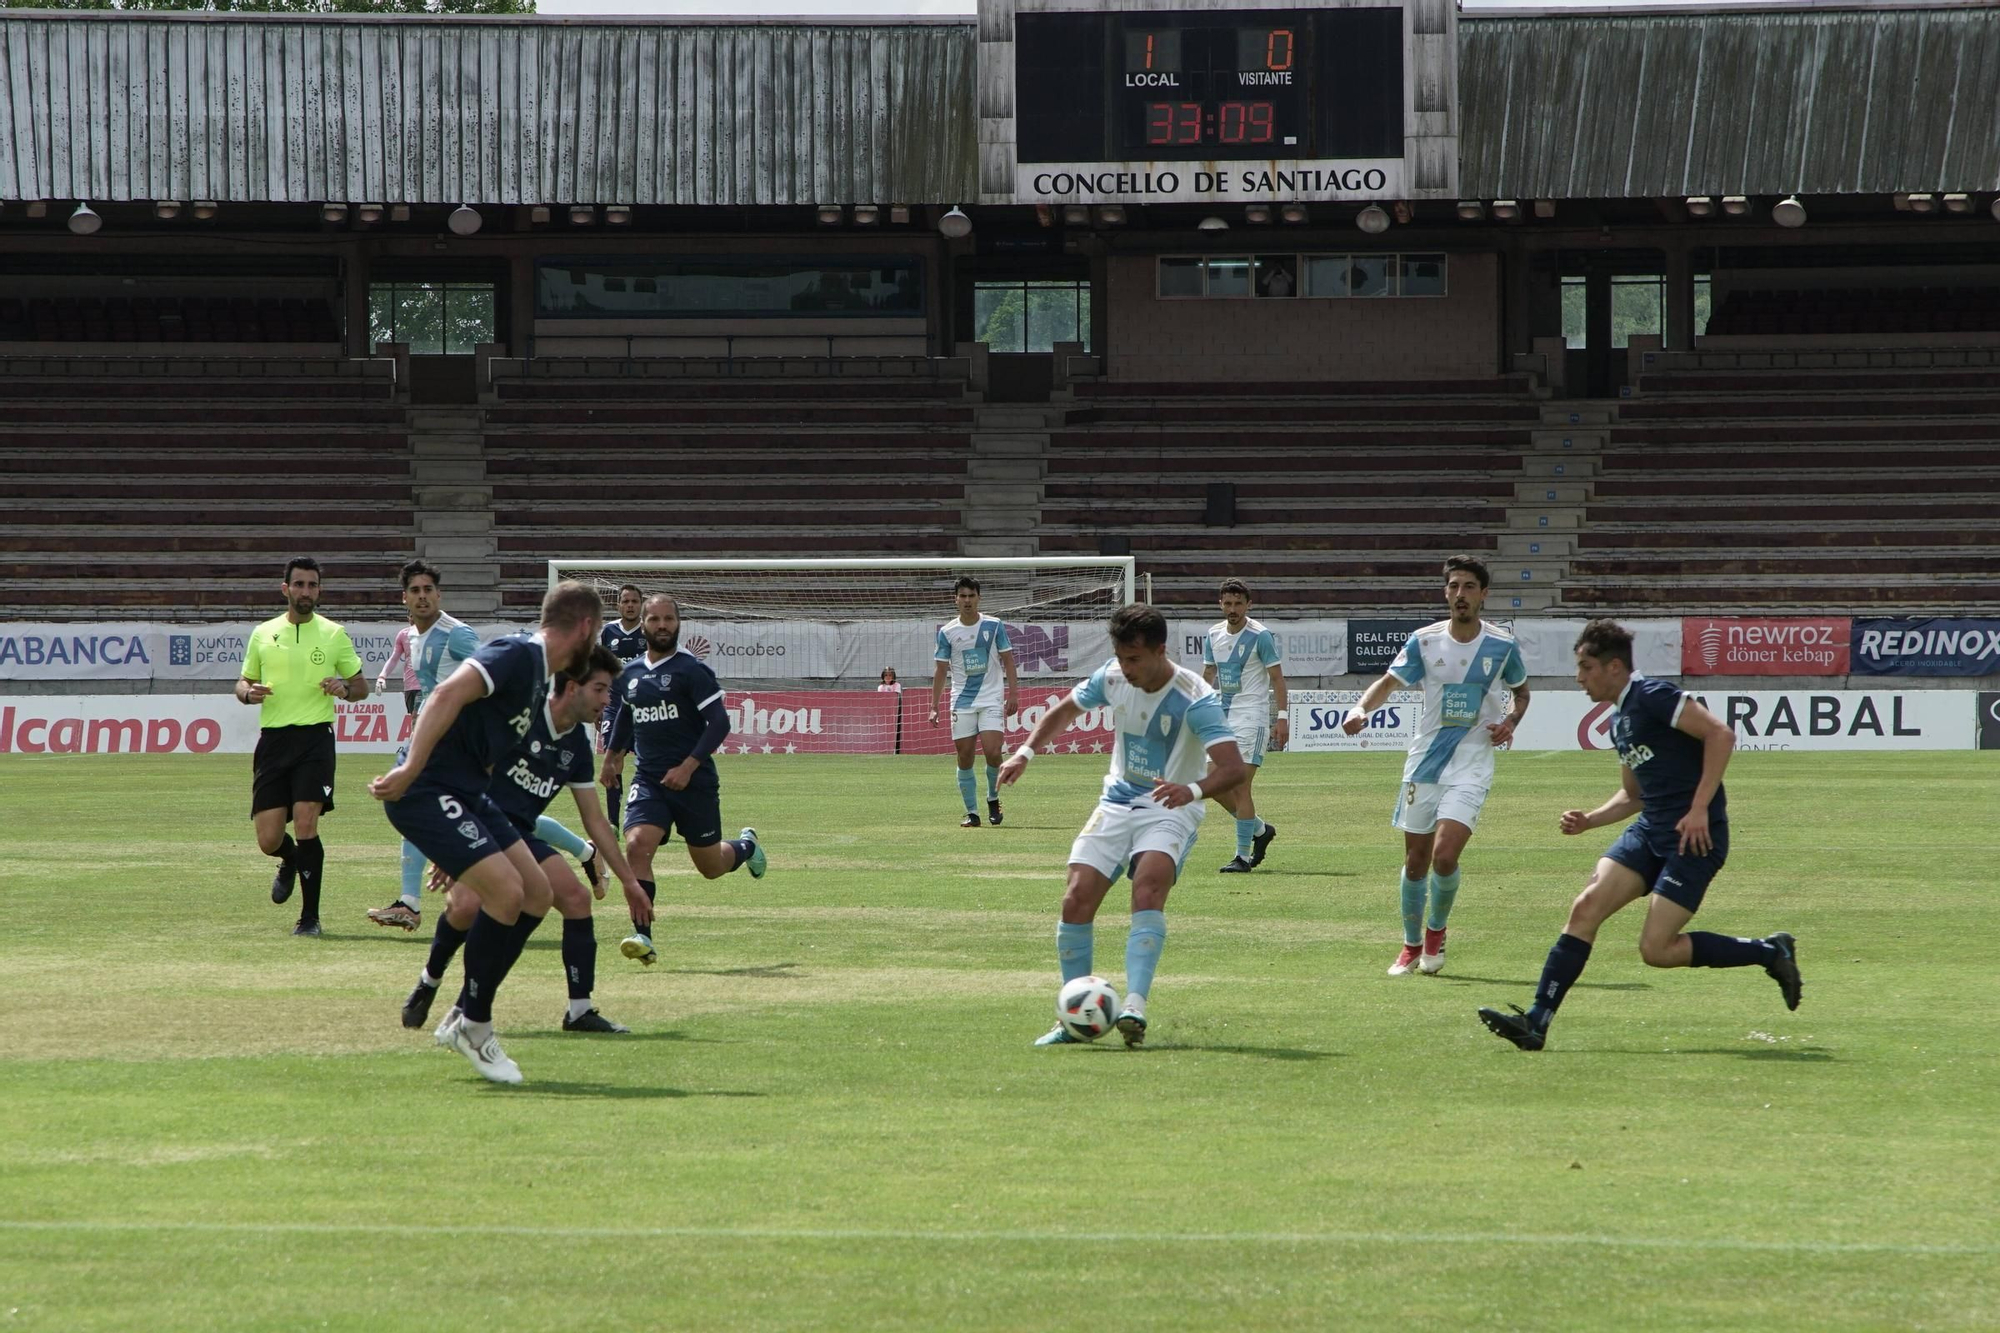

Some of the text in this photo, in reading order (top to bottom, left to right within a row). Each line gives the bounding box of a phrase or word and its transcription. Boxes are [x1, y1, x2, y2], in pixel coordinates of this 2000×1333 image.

[1146, 34, 1154, 69] 1
[1266, 29, 1294, 70] 0
[1125, 73, 1180, 86] LOCAL
[1238, 71, 1293, 85] VISITANTE
[1150, 102, 1274, 144] 33:09
[1033, 169, 1387, 194] CONCELLO DE SANTIAGO
[197, 637, 245, 649] XUNTA
[351, 637, 393, 648] UNTA
[1355, 632, 1384, 642] REAL
[1728, 626, 1834, 645] newroz
[0, 636, 150, 665] ABANCA
[716, 642, 786, 657] Xacobeo
[1185, 635, 1207, 655] EN
[1355, 645, 1398, 656] GALEGA
[1860, 630, 2000, 660] REDINOX
[196, 651, 214, 663] DE
[1726, 645, 1836, 667] döner kebap
[346, 702, 385, 714] LÁZARO
[1446, 699, 1467, 709] San
[1309, 706, 1401, 731] SOAS
[1446, 709, 1477, 719] Rafael
[1697, 695, 1922, 737] RABAL
[1128, 750, 1149, 766] San
[1127, 761, 1161, 779] Rafael
[627, 783, 640, 804] 6
[438, 794, 463, 819] 5
